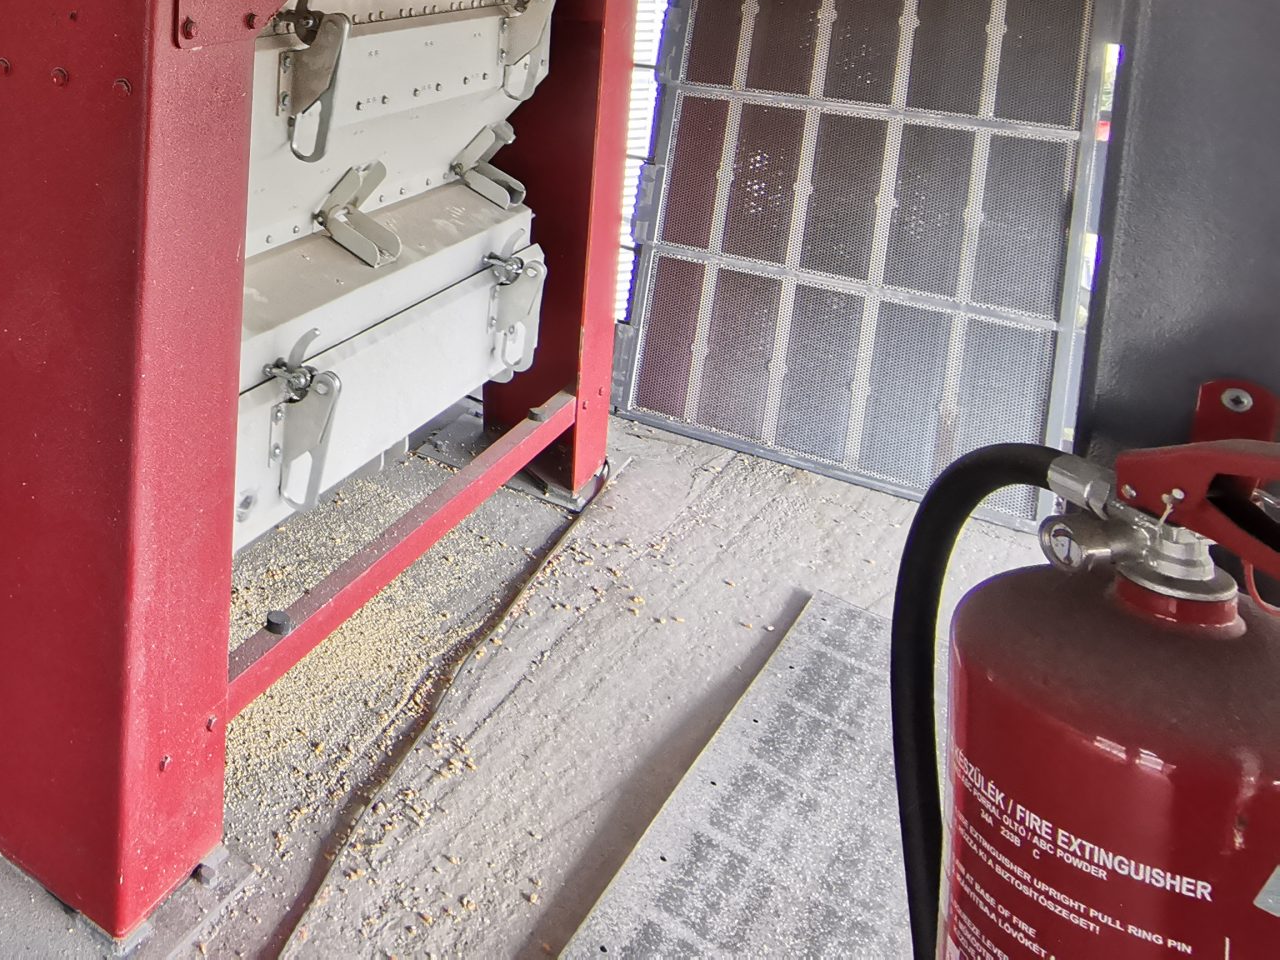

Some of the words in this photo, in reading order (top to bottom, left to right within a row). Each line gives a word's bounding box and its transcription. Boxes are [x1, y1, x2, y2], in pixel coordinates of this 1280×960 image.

[1016, 803, 1053, 841] FIRE
[1056, 827, 1213, 902] EXTINGUISHER
[1032, 848, 1041, 860] C
[1032, 835, 1055, 855] ABC
[1056, 848, 1108, 881] POWDER
[969, 824, 1032, 884] EXTINGUISHER
[1033, 878, 1087, 914] UPRIGHT
[1089, 908, 1125, 932] PULL
[1127, 924, 1164, 945] RING
[1167, 938, 1193, 955] PIN
[974, 881, 997, 908] BASE
[997, 904, 1011, 918] OF
[1012, 914, 1037, 938] FIRE
